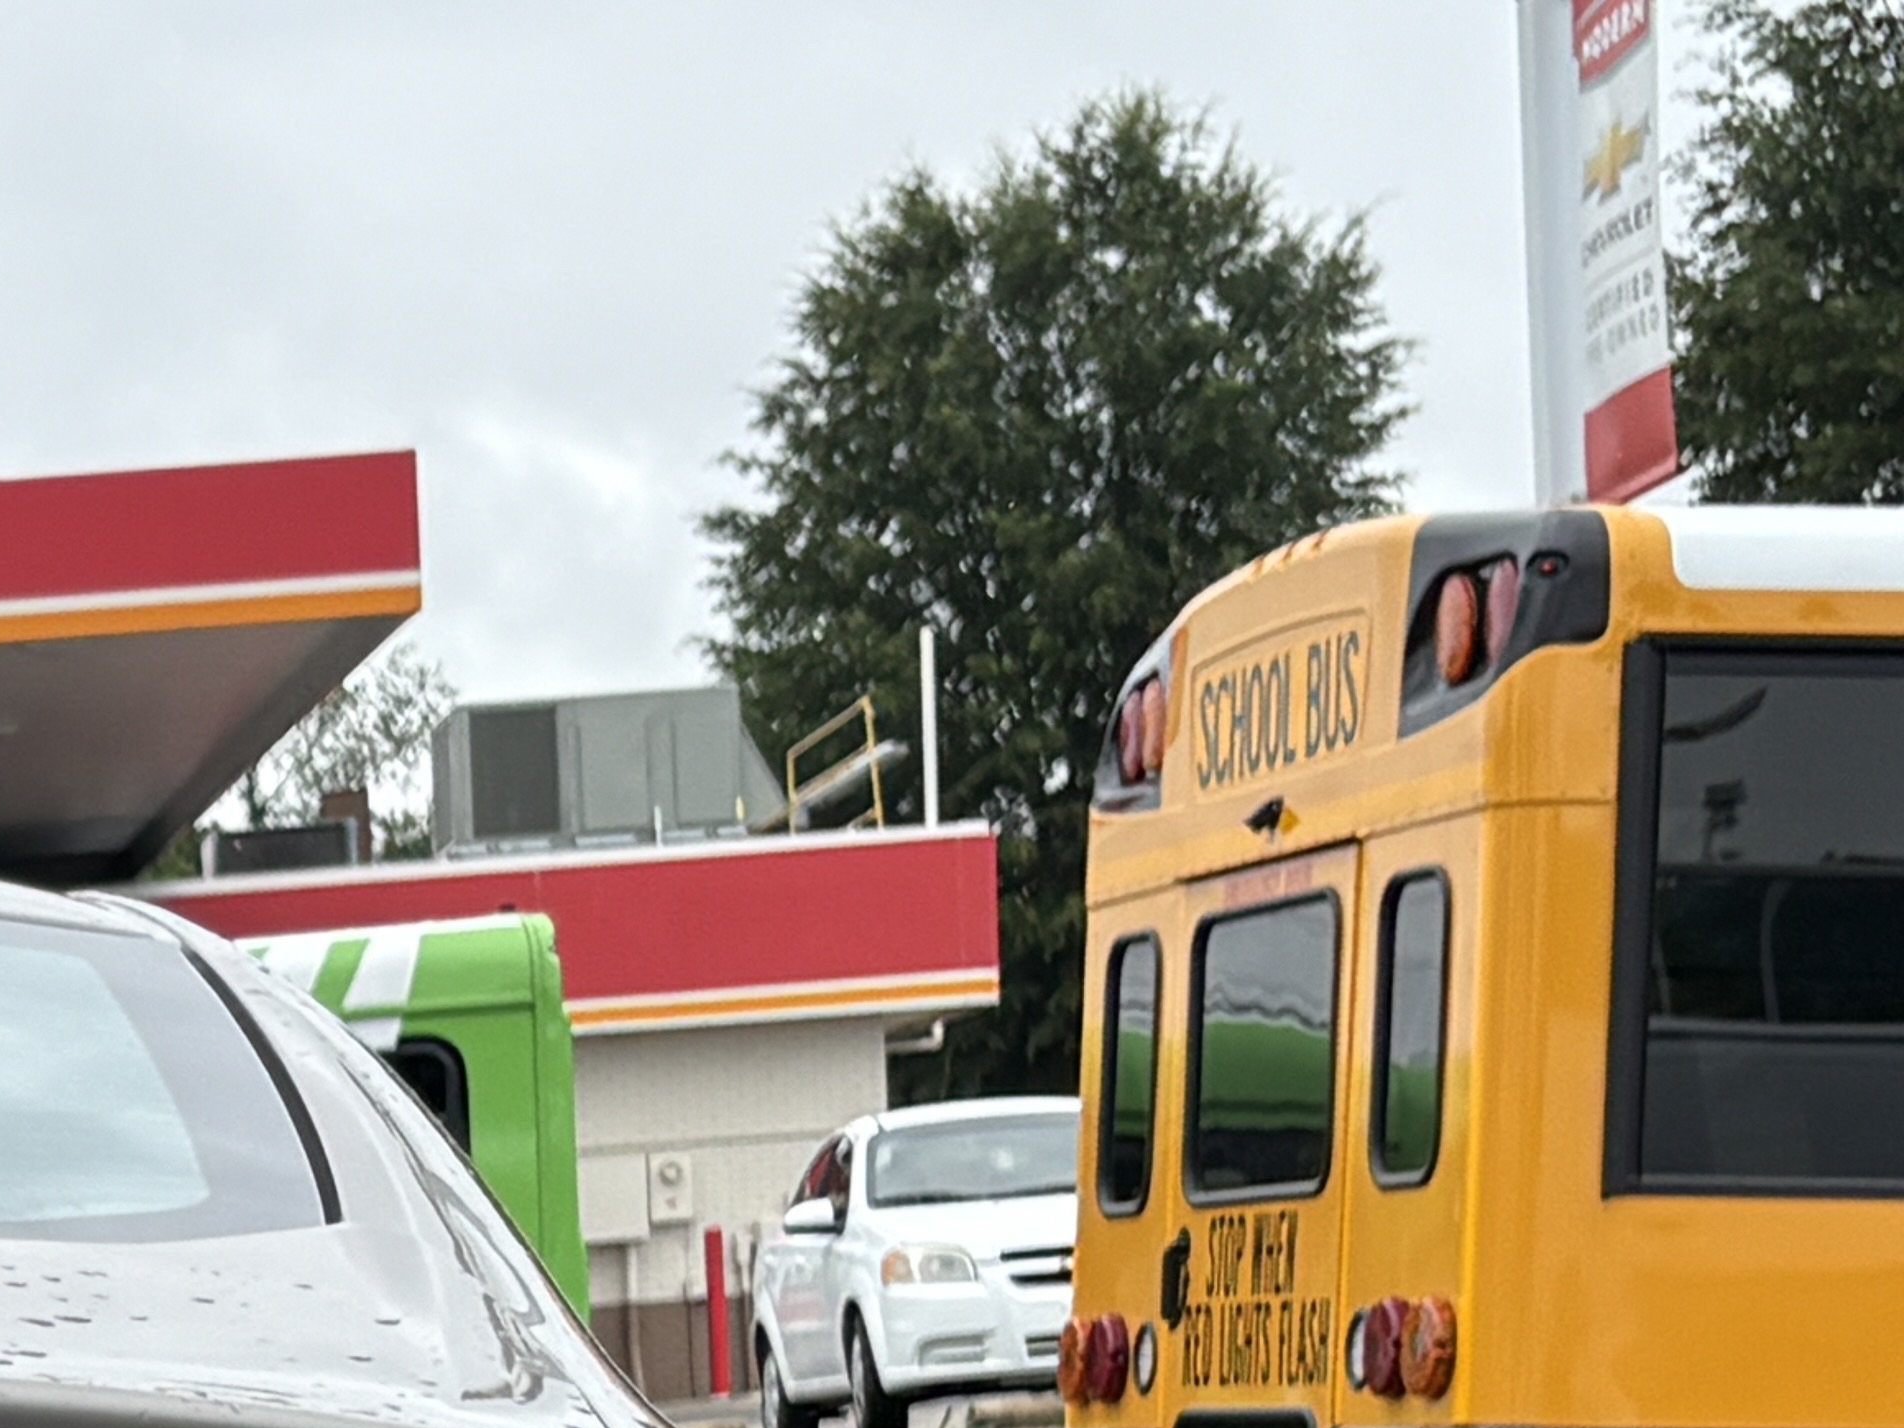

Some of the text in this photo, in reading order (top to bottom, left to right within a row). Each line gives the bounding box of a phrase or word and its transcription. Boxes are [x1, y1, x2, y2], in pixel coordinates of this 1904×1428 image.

[1197, 629, 1360, 790] SCHOOL BUS
[1206, 1210, 1298, 1297] STOP WHEN
[1182, 1298, 1331, 1387] RED LIGHTS FLASH
